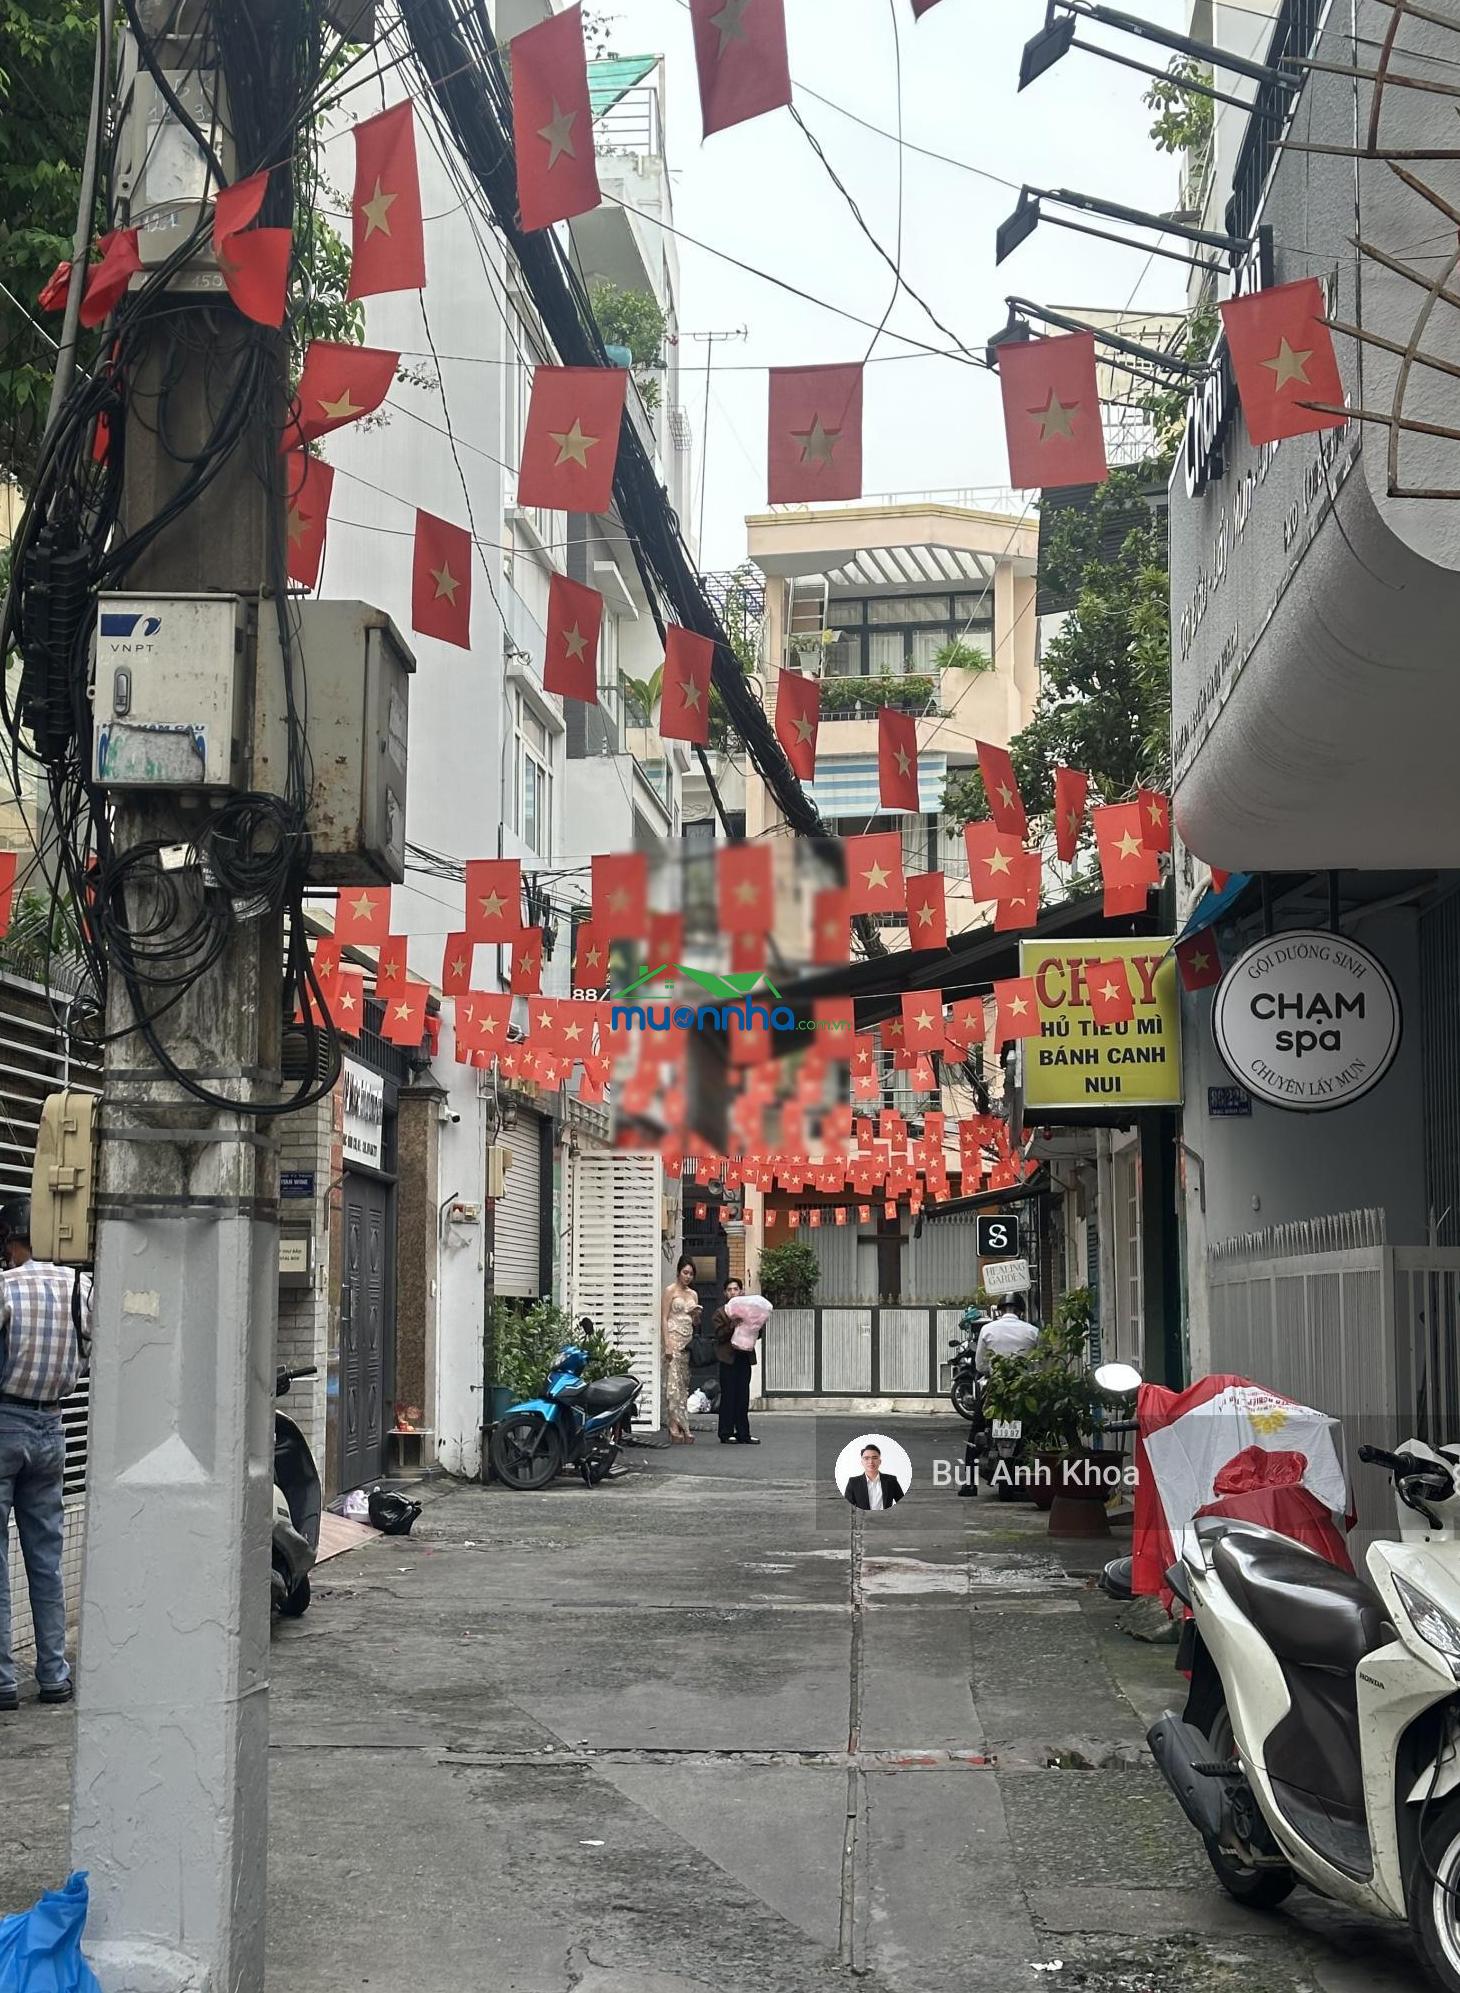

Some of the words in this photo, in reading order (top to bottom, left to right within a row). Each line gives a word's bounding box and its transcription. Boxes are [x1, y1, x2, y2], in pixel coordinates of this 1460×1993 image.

[110, 644, 154, 653] VNPT
[1332, 950, 1367, 979] SINH
[1036, 956, 1164, 1008] CHY
[1250, 992, 1366, 1025] CHẠM
[1137, 1014, 1163, 1035] MÌ
[1040, 1045, 1099, 1066] BÁNH
[1107, 1046, 1166, 1064] CANH
[1276, 1029, 1342, 1058] spa
[1085, 1076, 1121, 1093] NUI
[1335, 1057, 1367, 1088] MỤN
[1359, 1672, 1385, 1689] HONDA
